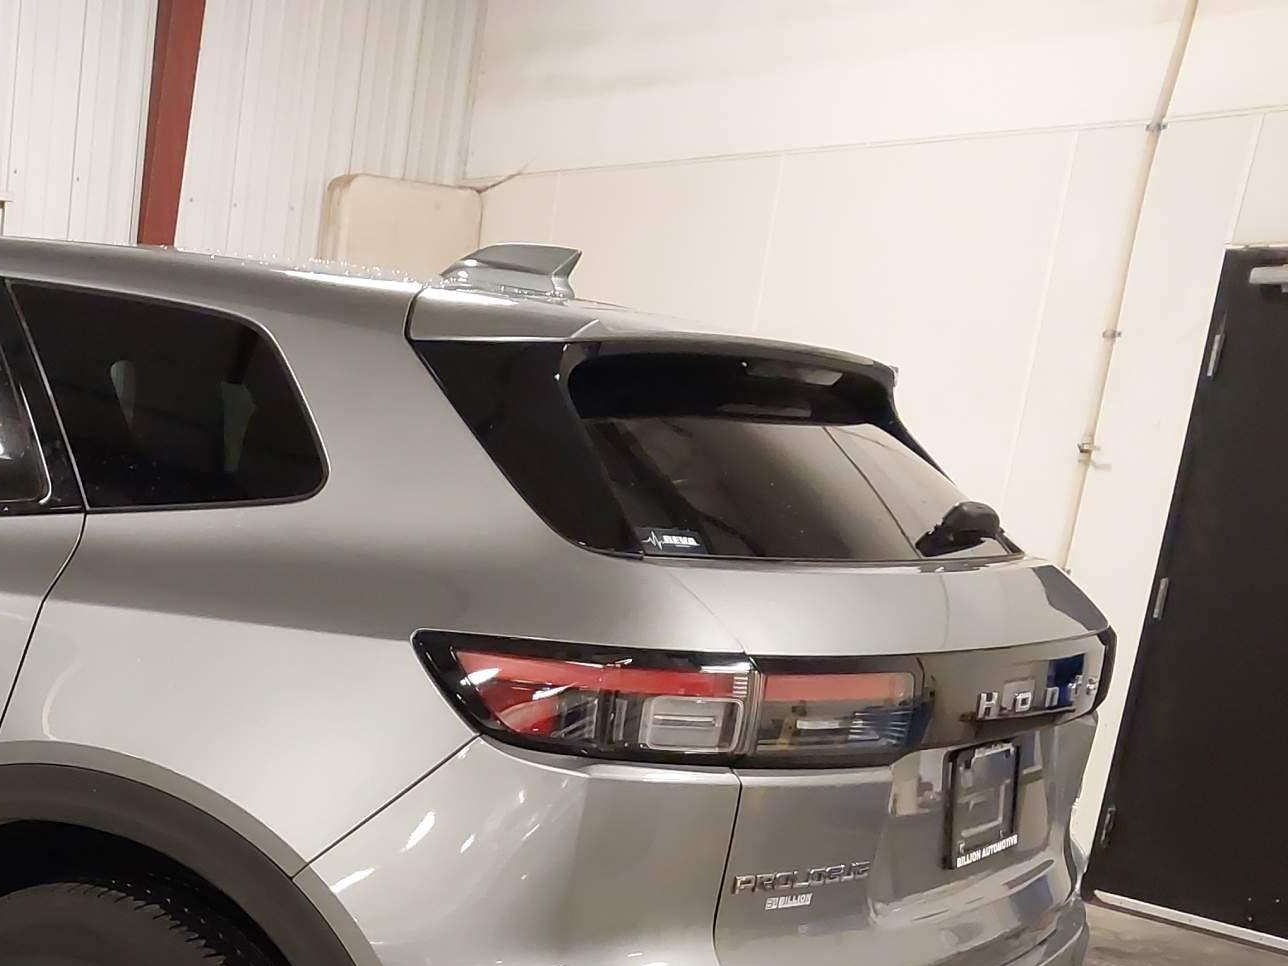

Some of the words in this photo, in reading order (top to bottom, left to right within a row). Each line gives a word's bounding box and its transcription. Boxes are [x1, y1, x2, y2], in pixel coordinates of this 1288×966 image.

[978, 676, 1098, 720] HON
[957, 849, 981, 868] BILLION
[982, 834, 1018, 858] AUTOMOTIVE
[732, 861, 871, 894] PROLOGUE
[778, 893, 813, 908] BILLION
